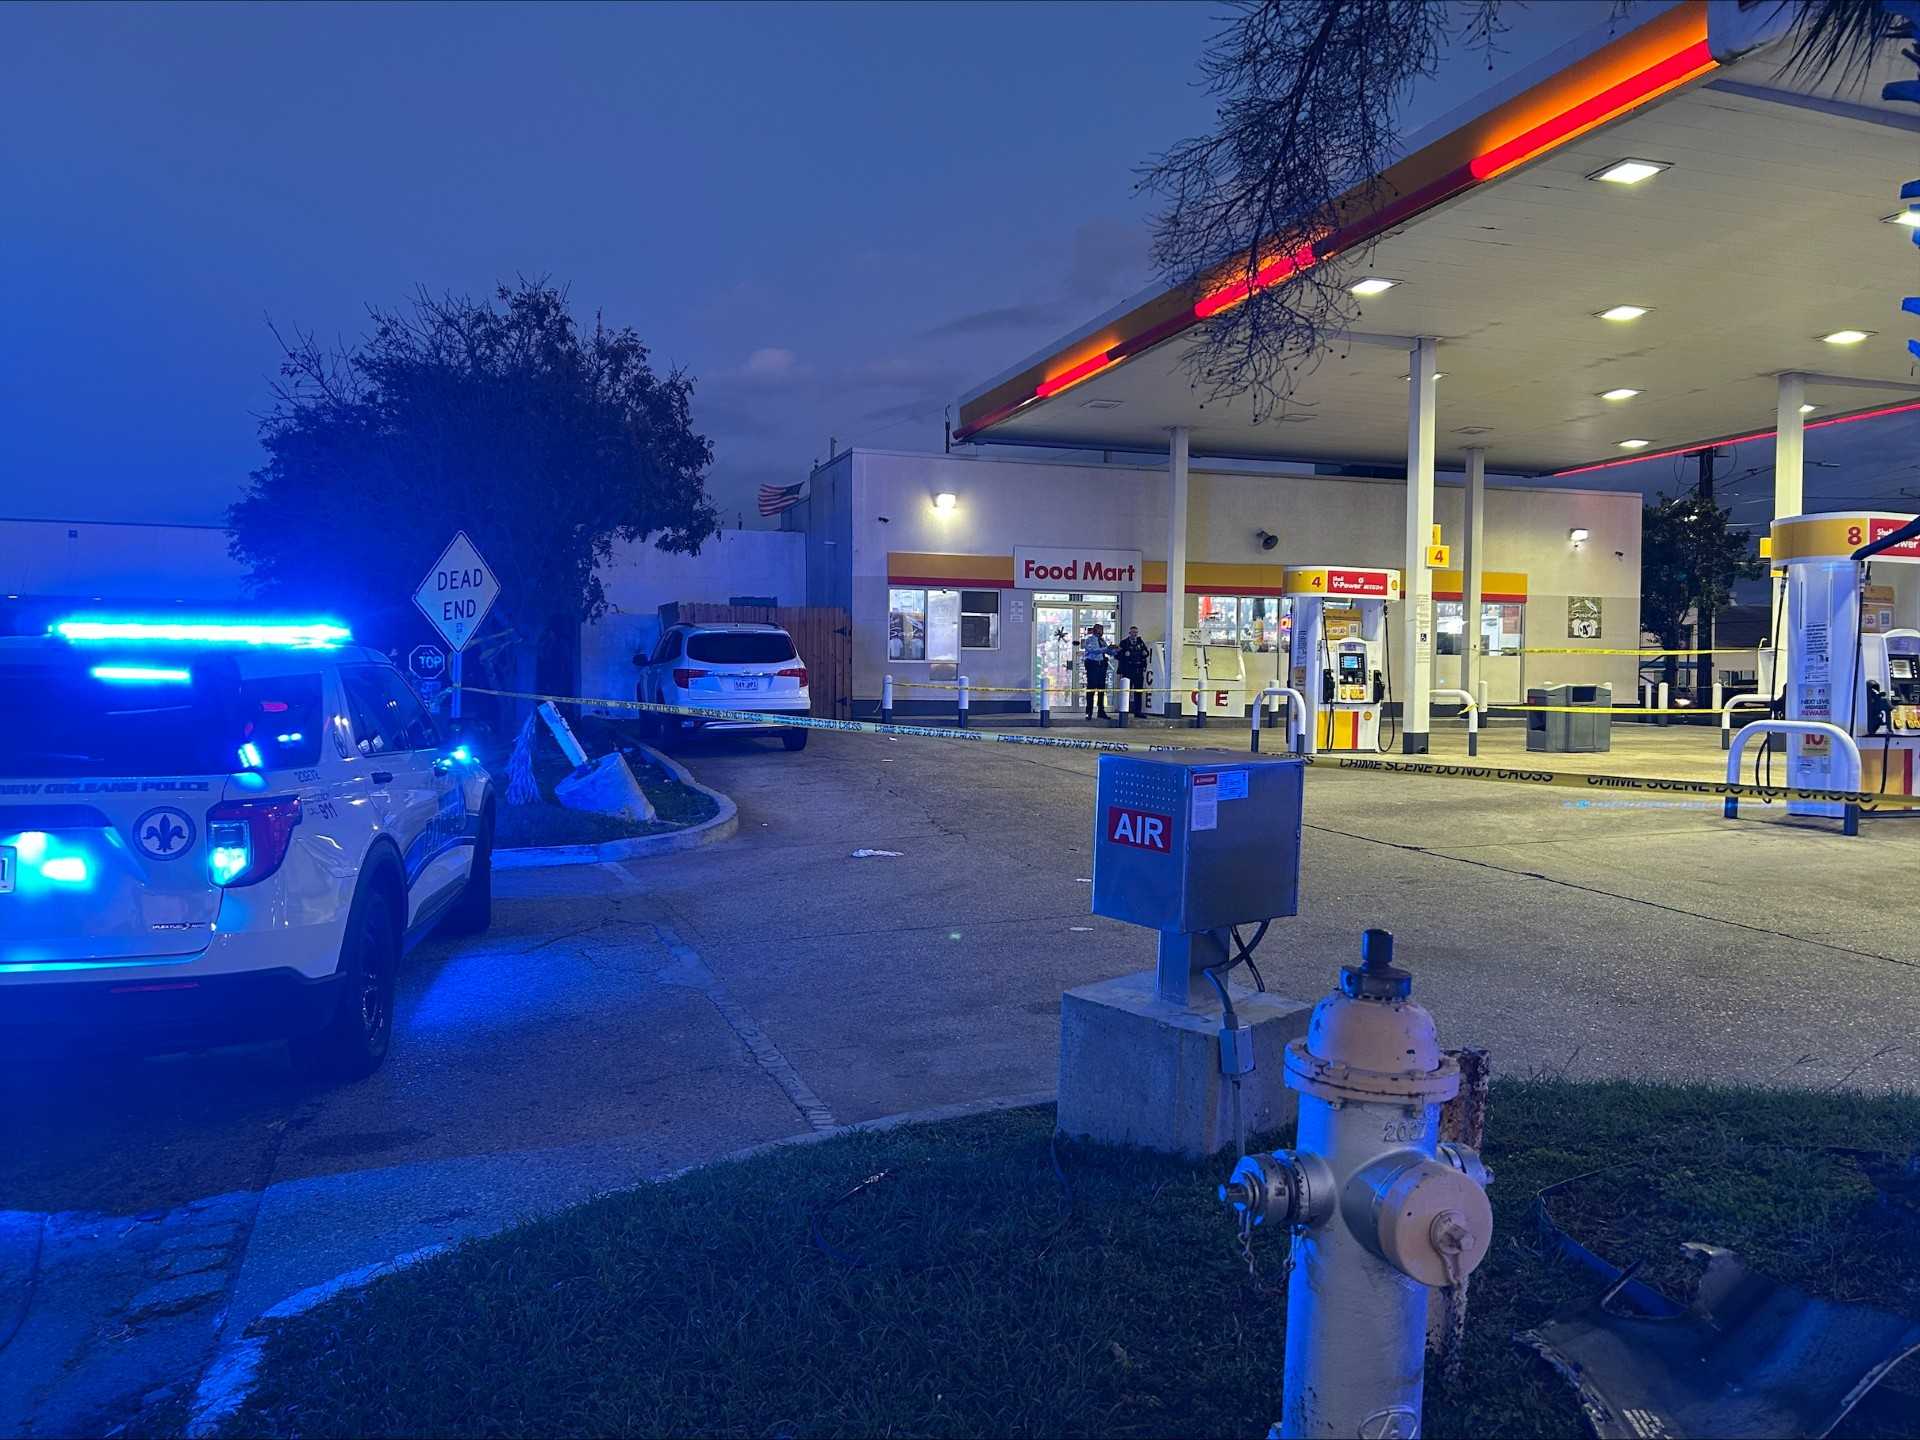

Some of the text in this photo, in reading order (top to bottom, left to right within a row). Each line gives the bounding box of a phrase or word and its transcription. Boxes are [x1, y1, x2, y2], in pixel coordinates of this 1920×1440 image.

[1848, 526, 1862, 545] 8
[1434, 550, 1444, 562] 4
[1024, 559, 1135, 581] Food Mart
[437, 568, 483, 591] DEAD
[1311, 576, 1321, 588] 4
[443, 599, 477, 621] END
[417, 655, 442, 670] TOP
[1145, 648, 1154, 709] ICE
[839, 720, 862, 732] CROSS
[997, 734, 1129, 752] CRIME SCENE DO NOT CROSS
[1339, 758, 1553, 782] CRIME SCENE DO NOT CROSS
[141, 781, 209, 792] POLICE
[318, 802, 338, 820] 911
[1113, 812, 1164, 849] AIR
